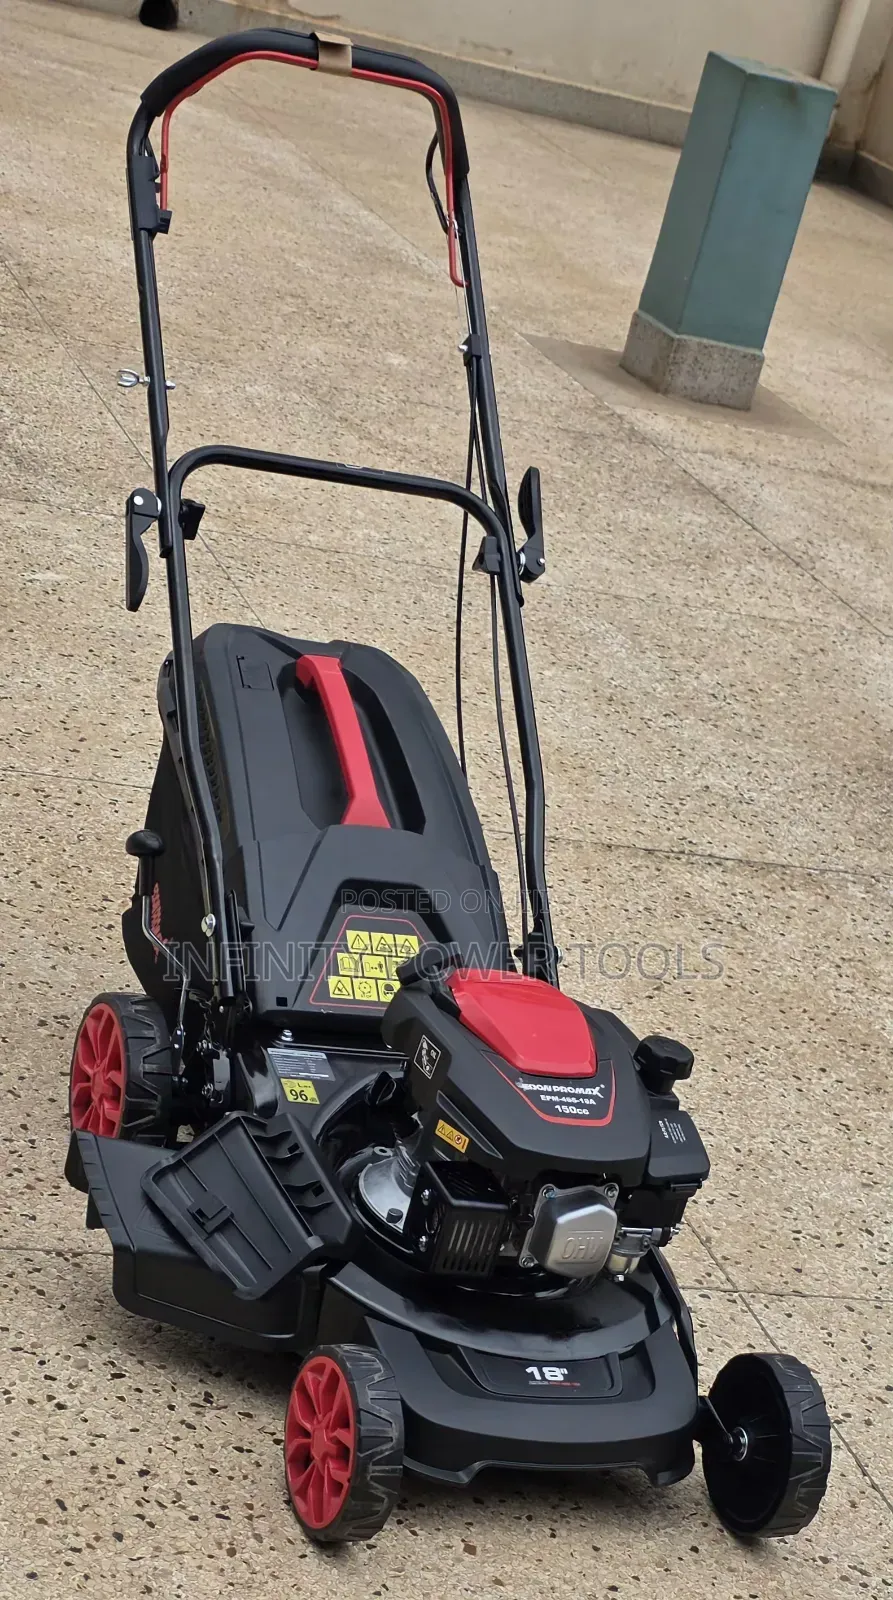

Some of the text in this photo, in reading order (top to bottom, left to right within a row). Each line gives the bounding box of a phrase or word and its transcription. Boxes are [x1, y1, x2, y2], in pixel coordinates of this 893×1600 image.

[289, 1088, 309, 1102] 96
[555, 1105, 590, 1115] 150cc
[560, 1236, 605, 1260] OHV
